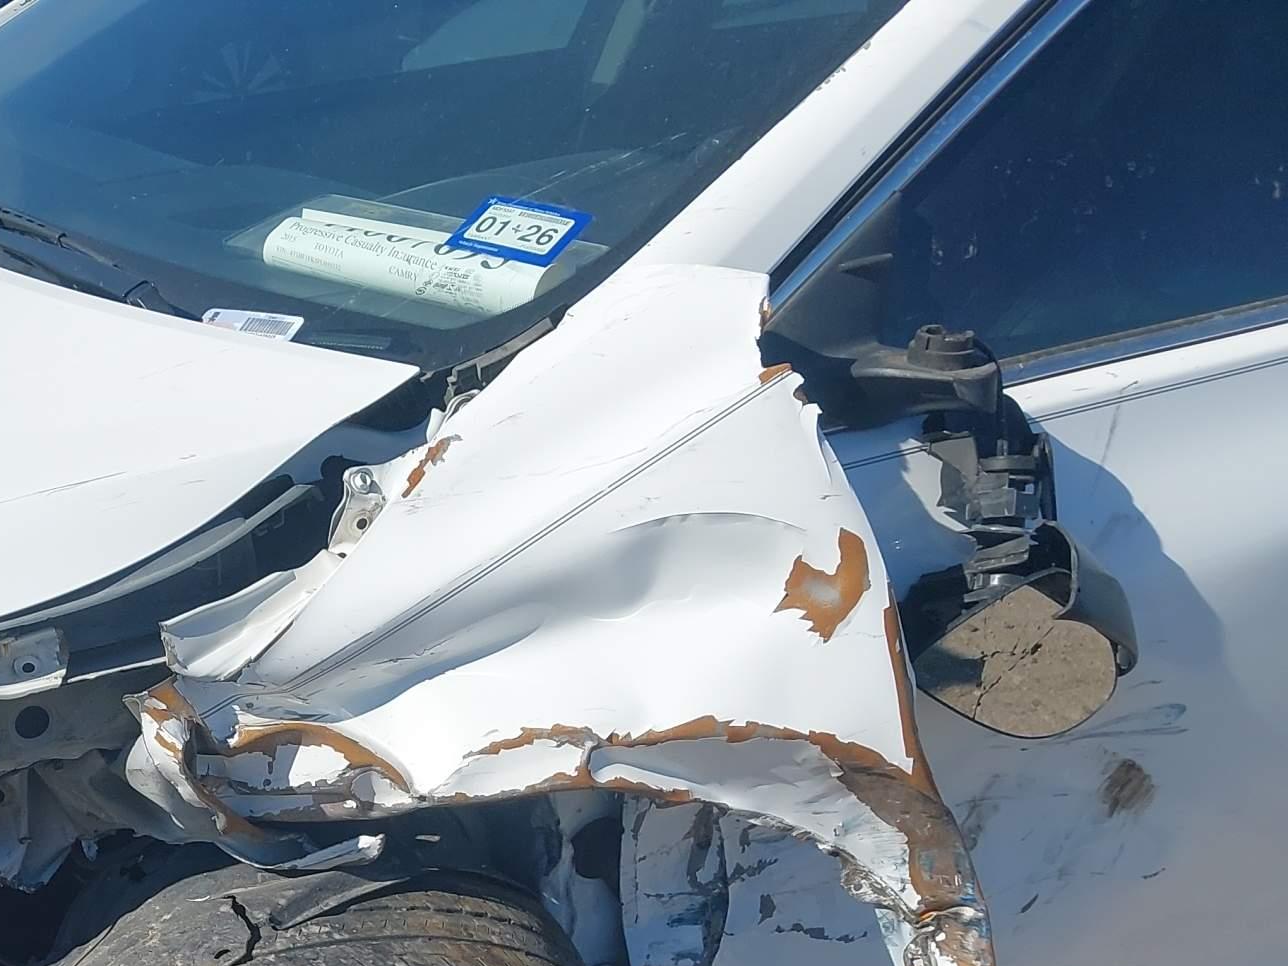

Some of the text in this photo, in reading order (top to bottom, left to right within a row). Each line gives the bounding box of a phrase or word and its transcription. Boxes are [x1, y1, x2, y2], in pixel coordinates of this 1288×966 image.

[289, 221, 344, 242] Progressive
[344, 233, 389, 257] Casualty
[475, 215, 511, 236] 01
[516, 224, 559, 246] 26
[314, 242, 344, 259] TOYOTA
[388, 265, 418, 282] CAMRY
